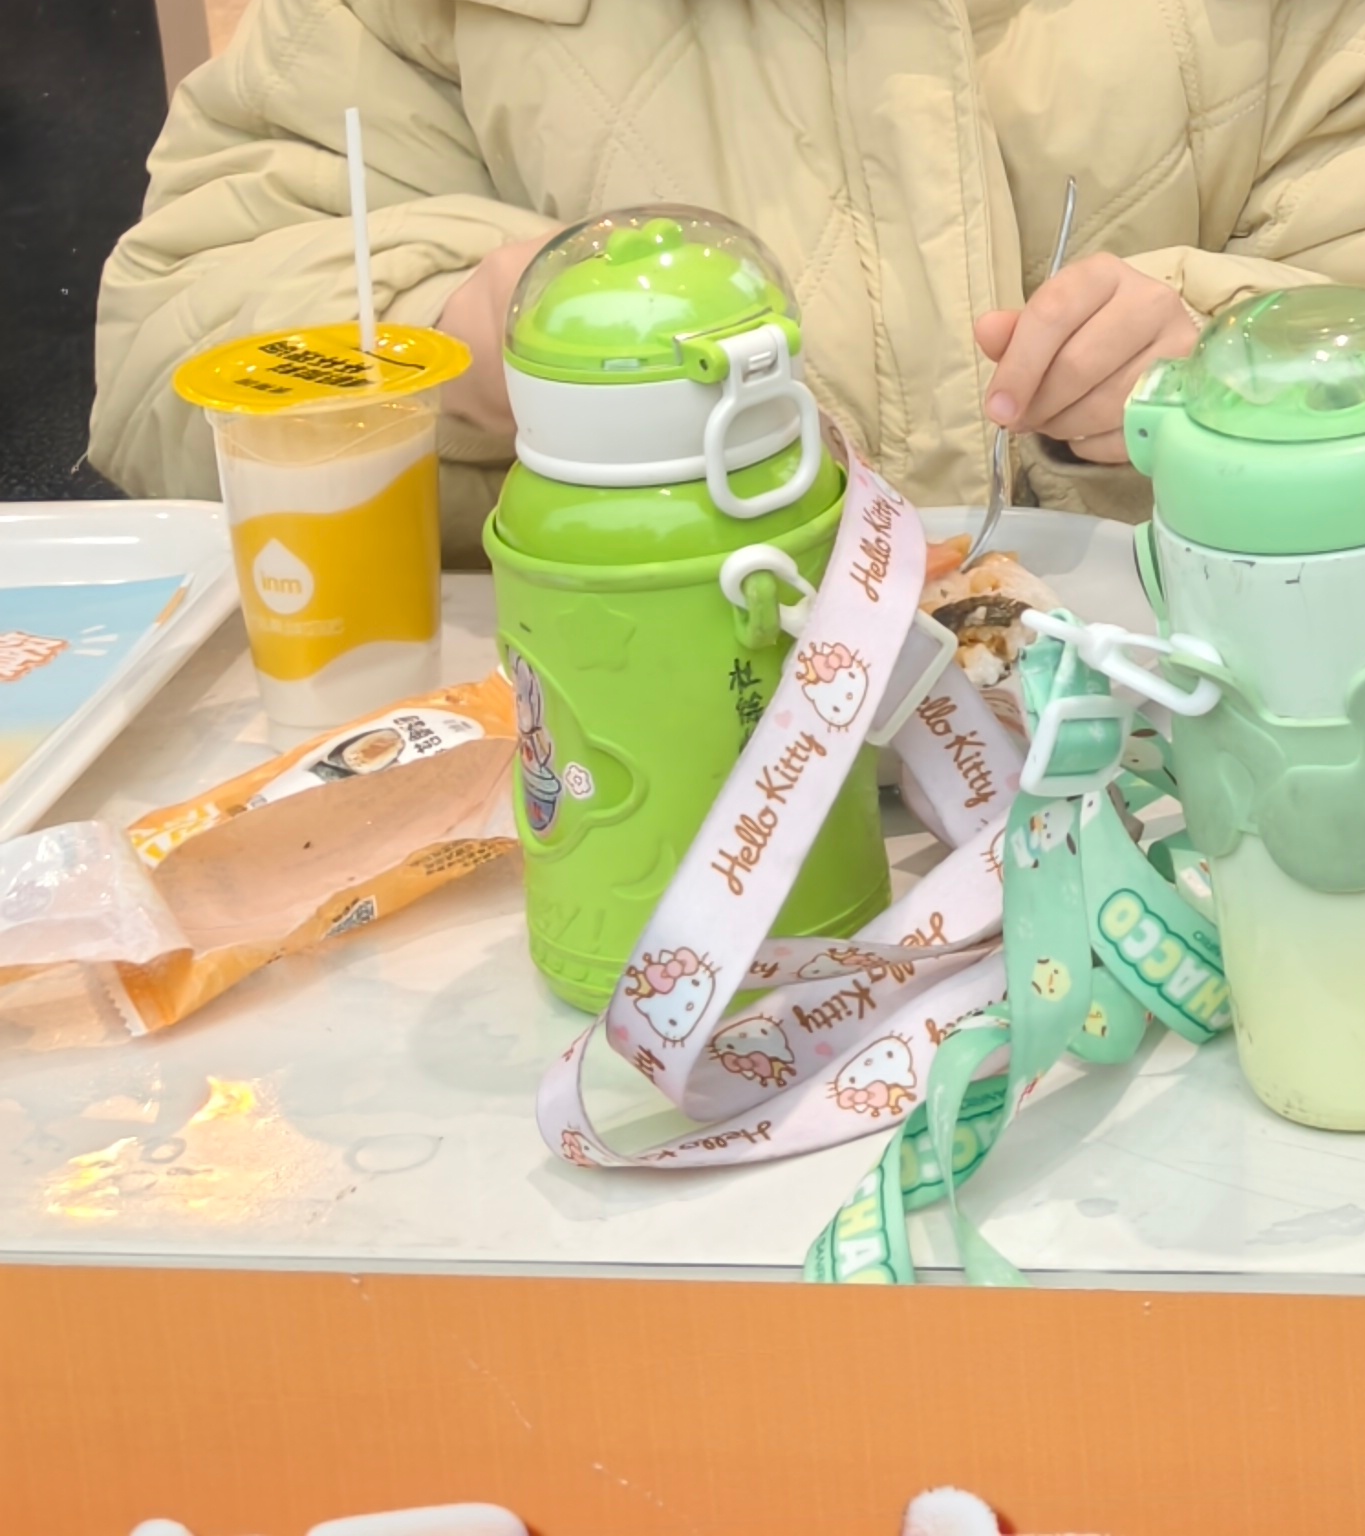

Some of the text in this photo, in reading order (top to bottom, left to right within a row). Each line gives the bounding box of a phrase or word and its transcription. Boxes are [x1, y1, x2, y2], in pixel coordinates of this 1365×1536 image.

[850, 494, 905, 604] Hello Kitty
[944, 729, 998, 809] Kitty
[710, 802, 780, 898] Hello
[755, 729, 828, 806] Kitty
[792, 979, 881, 1036] Kitty
[678, 1119, 773, 1152] Hello
